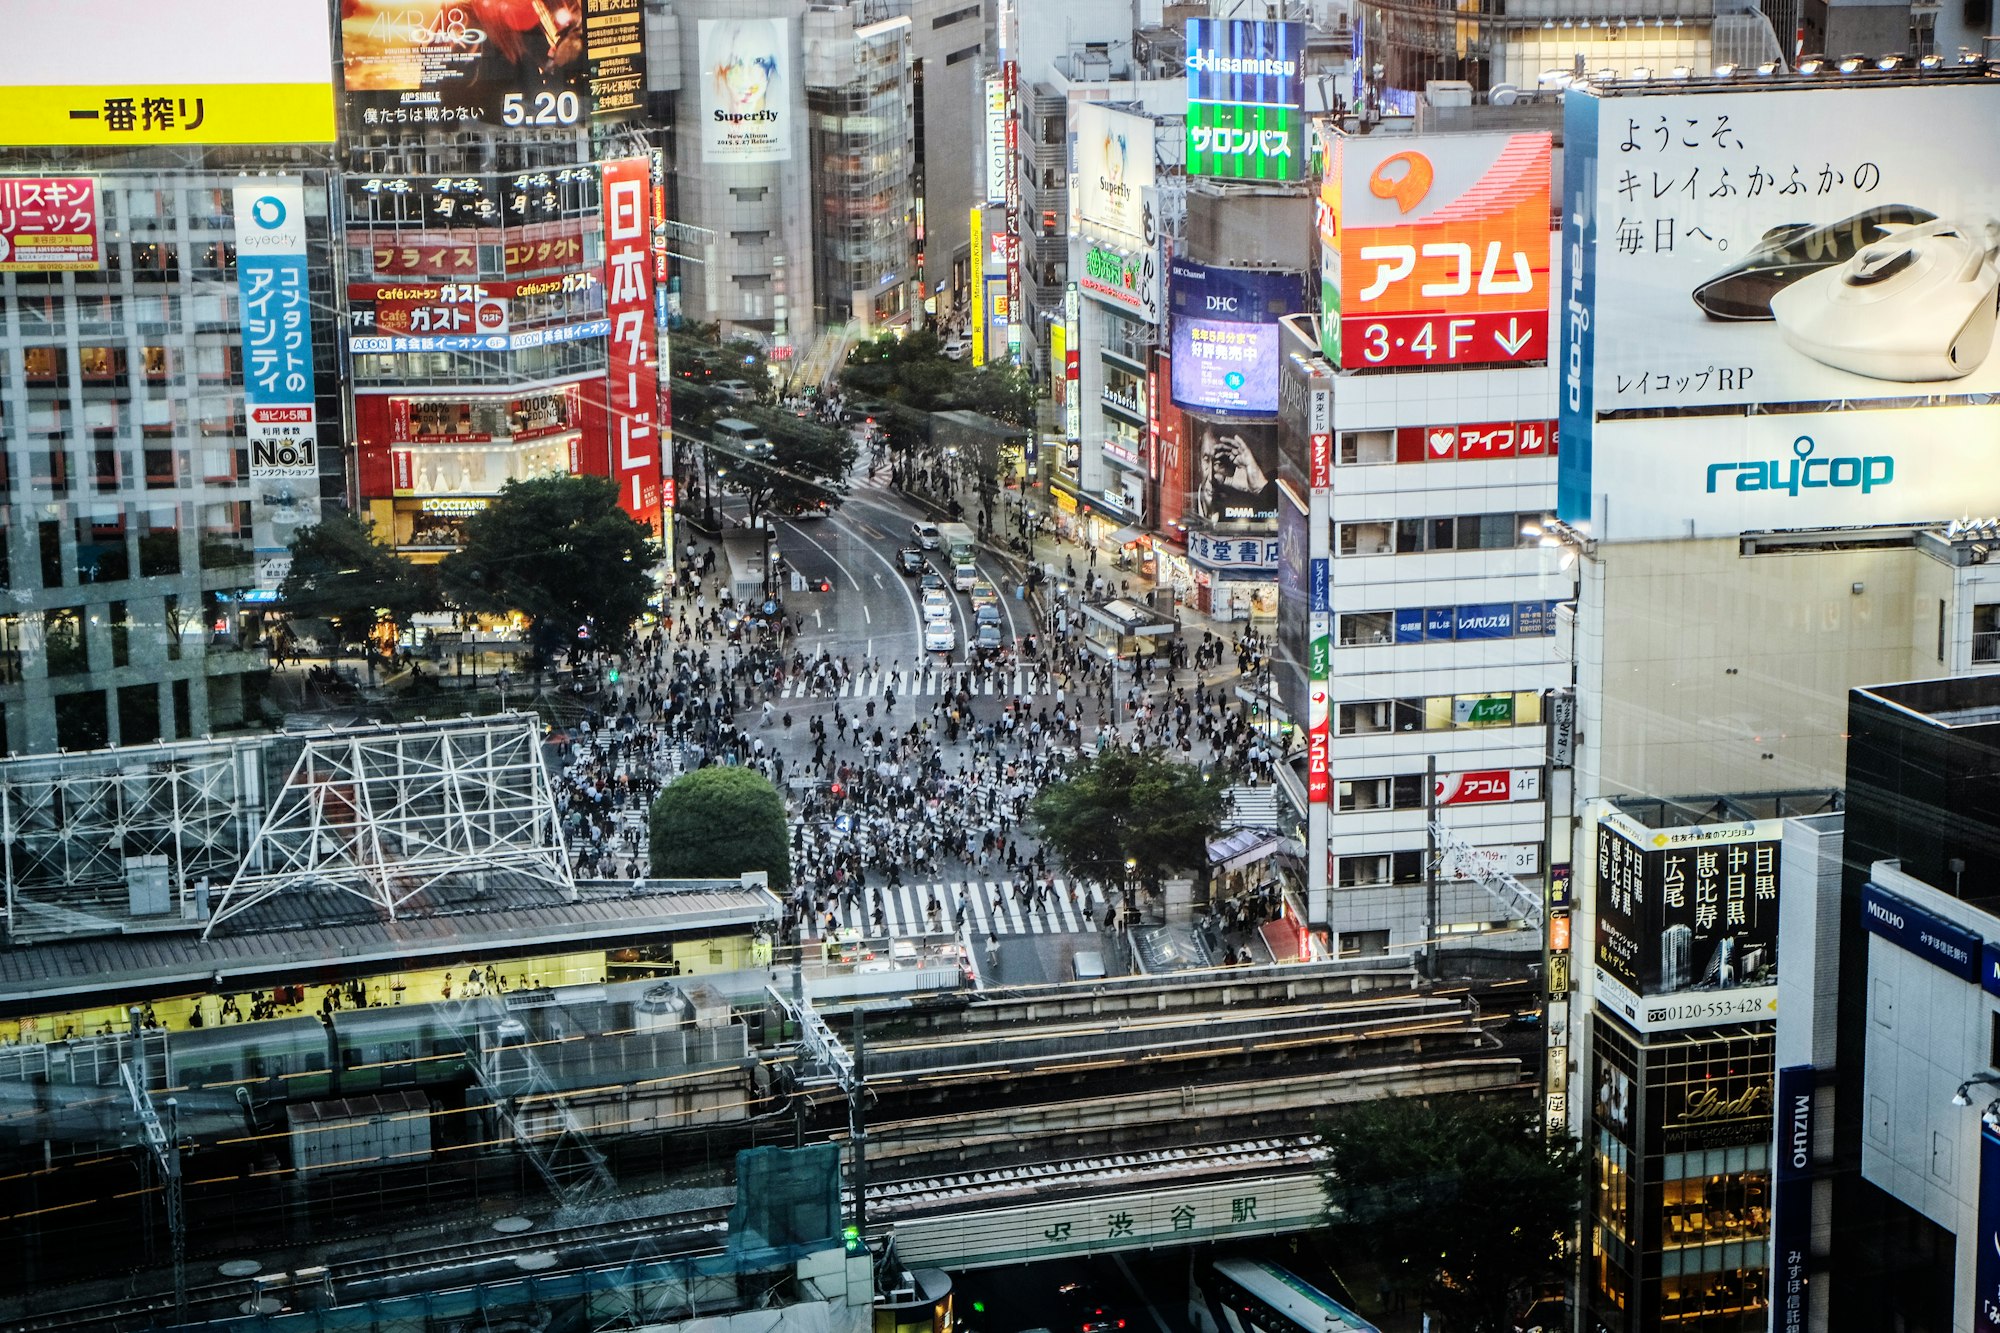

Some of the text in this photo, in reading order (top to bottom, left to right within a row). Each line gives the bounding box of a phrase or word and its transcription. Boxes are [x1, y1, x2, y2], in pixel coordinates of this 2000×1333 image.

[368, 8, 466, 43] AKB48
[1186, 49, 1295, 76] Hisamitsu
[69, 97, 205, 131] 一番搾り
[363, 106, 484, 123] 僕たちは戦わない
[502, 91, 579, 125] 5.20
[714, 109, 778, 124] Superfly
[1191, 126, 1291, 157] サロンパス
[1619, 115, 1744, 153] ようこそ、
[1100, 175, 1131, 201] Superfly
[1617, 162, 1881, 203] キレイふかふかの
[245, 235, 297, 248] eyecity
[1615, 216, 1728, 255] 毎日へ。
[375, 251, 474, 268] プライス
[505, 240, 580, 265] コンタクト
[1360, 241, 1533, 301] アコム
[377, 285, 488, 302] Café レストラン ガスト
[517, 284, 535, 297] Café
[561, 273, 597, 294] ガスト
[380, 310, 407, 321] Café
[1206, 296, 1237, 311] DHC
[1567, 213, 1589, 412] raycop
[246, 268, 280, 392] アイシティ
[281, 268, 306, 392] コンタクトの
[351, 311, 375, 326] 7F
[410, 307, 470, 331] ガスト
[353, 339, 388, 349] AEON
[394, 337, 483, 350] 英会話イーオン
[514, 321, 609, 346] AEON 英会話イーオン
[609, 179, 650, 511] 日本ダービー
[259, 409, 308, 421] 当ビル5階
[410, 403, 449, 413] 1000%
[519, 394, 560, 414] 1000%
[262, 427, 301, 436] 利用者数
[1460, 429, 1542, 451] アイフル
[250, 439, 316, 467] No.1
[1314, 445, 1326, 487] アイフル
[252, 468, 316, 477] コンタクトショップ
[1706, 435, 1894, 498] raycop
[422, 499, 486, 511] L'OCCITANE
[1190, 530, 1279, 562] 大盛堂書店
[1314, 561, 1325, 610] レオパレス21
[1459, 614, 1510, 630] レオパレス21
[1313, 645, 1324, 674] レイク
[1478, 704, 1507, 717] レイク
[1312, 734, 1325, 773] アコム
[1464, 778, 1506, 796] アコム
[1516, 779, 1535, 791] 4F
[1516, 854, 1534, 866] 3F
[1664, 855, 1686, 908] 広尾
[1727, 847, 1748, 925] 中目黒
[1755, 847, 1776, 900] 目黒
[1696, 852, 1719, 929] 恵比寿
[1867, 900, 1904, 930] MIZUHO
[1920, 931, 1968, 964] みずほ信託銀行
[1668, 998, 1762, 1020] 0120-553-428
[1552, 1050, 1562, 1058] 3F
[1677, 1087, 1761, 1119] Lindt
[1793, 1095, 1809, 1168] MIZUHO
